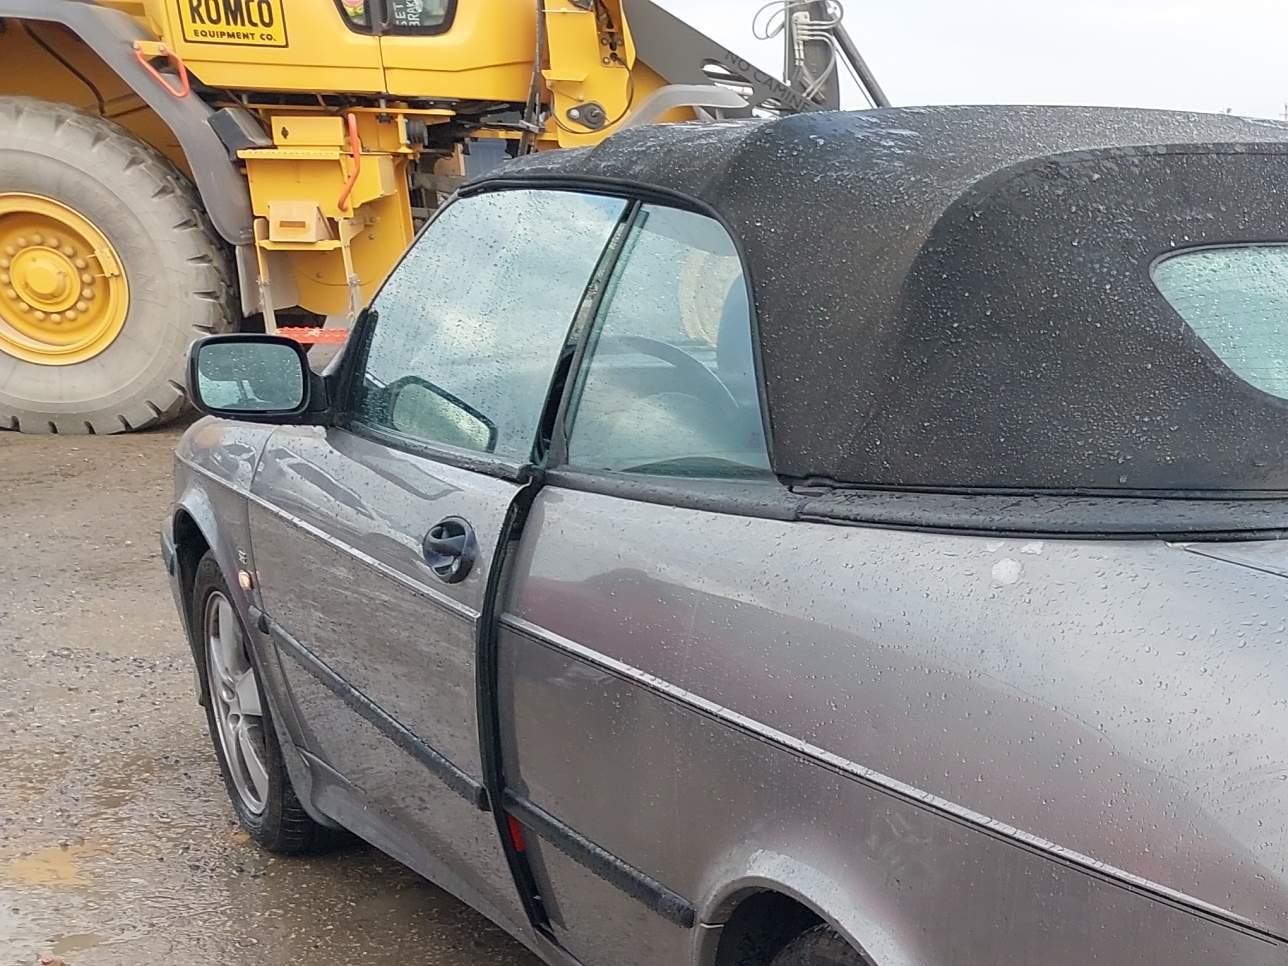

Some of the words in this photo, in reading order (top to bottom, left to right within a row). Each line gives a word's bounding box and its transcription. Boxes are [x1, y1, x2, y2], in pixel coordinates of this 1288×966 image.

[188, 0, 275, 28] ROMCO
[193, 29, 256, 41] EQUIPMENT
[259, 33, 277, 42] CO.
